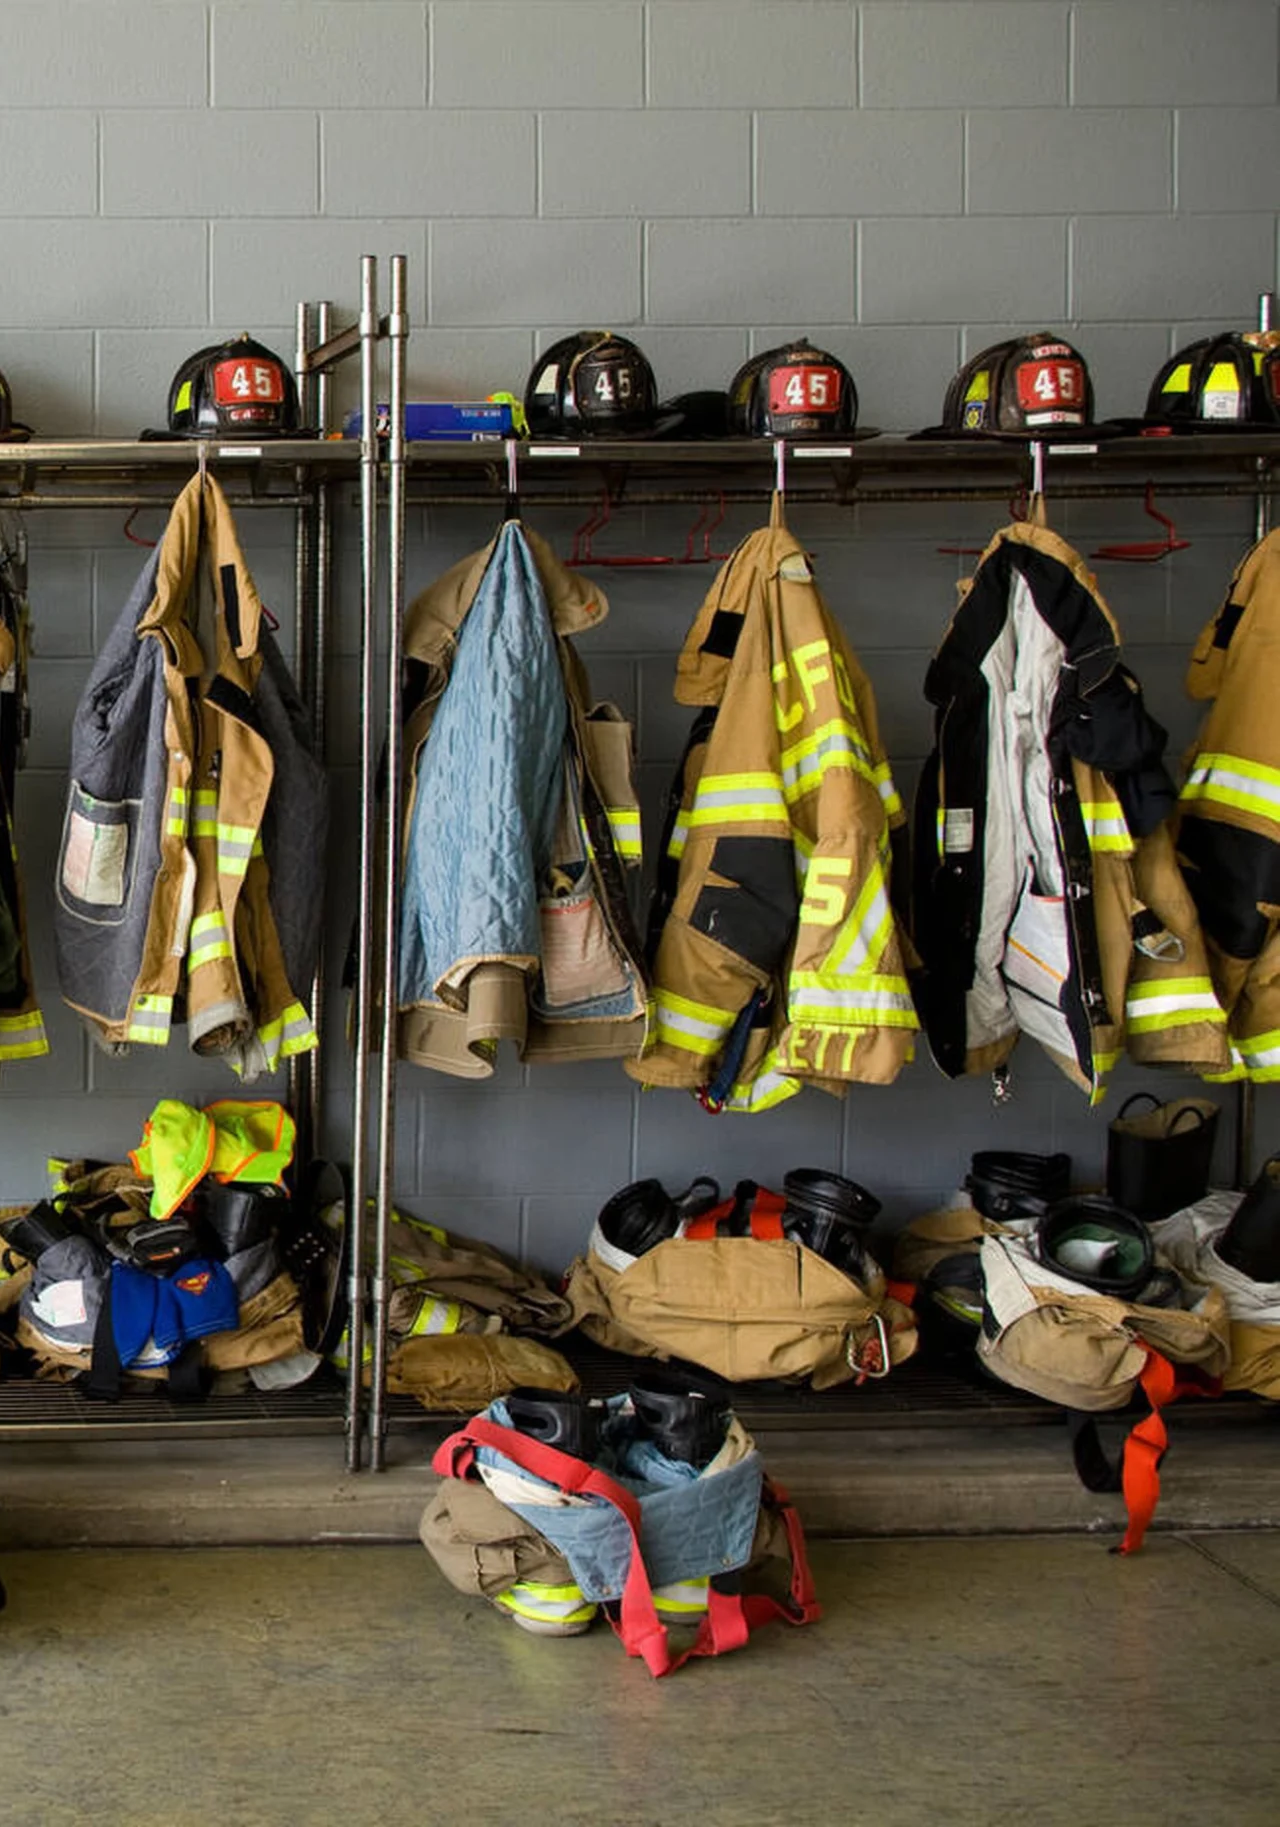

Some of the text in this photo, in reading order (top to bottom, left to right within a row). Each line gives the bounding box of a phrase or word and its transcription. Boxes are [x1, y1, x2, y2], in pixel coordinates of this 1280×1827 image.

[231, 366, 272, 397] 45
[595, 369, 631, 401] 45
[785, 374, 829, 406] 45
[1033, 367, 1074, 399] 45
[799, 857, 852, 926] 5
[774, 1022, 867, 1073] ETT
